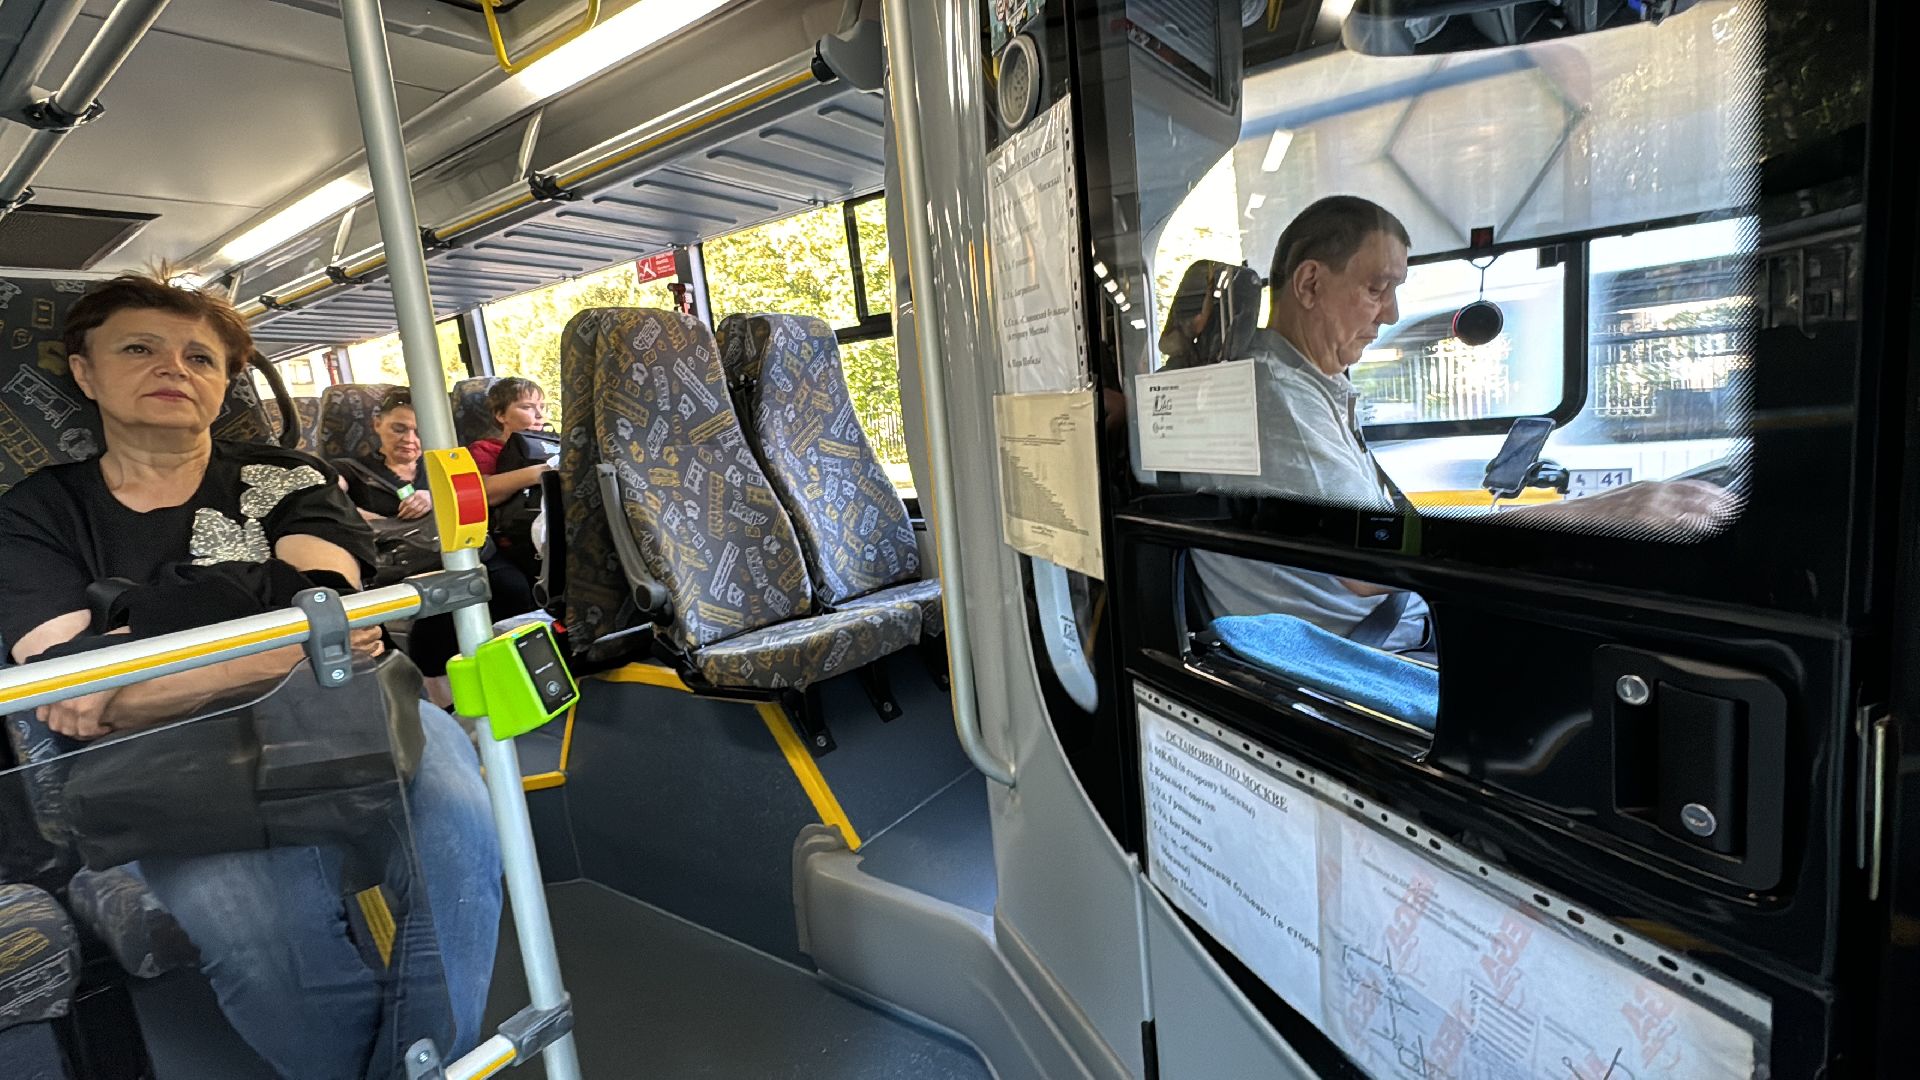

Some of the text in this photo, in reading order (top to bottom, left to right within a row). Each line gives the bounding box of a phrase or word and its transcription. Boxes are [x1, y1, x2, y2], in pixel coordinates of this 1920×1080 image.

[1165, 730, 1288, 810] ОСТАНОВКИ ПО МОСКВЕ
[1287, 926, 1322, 957] сторон
